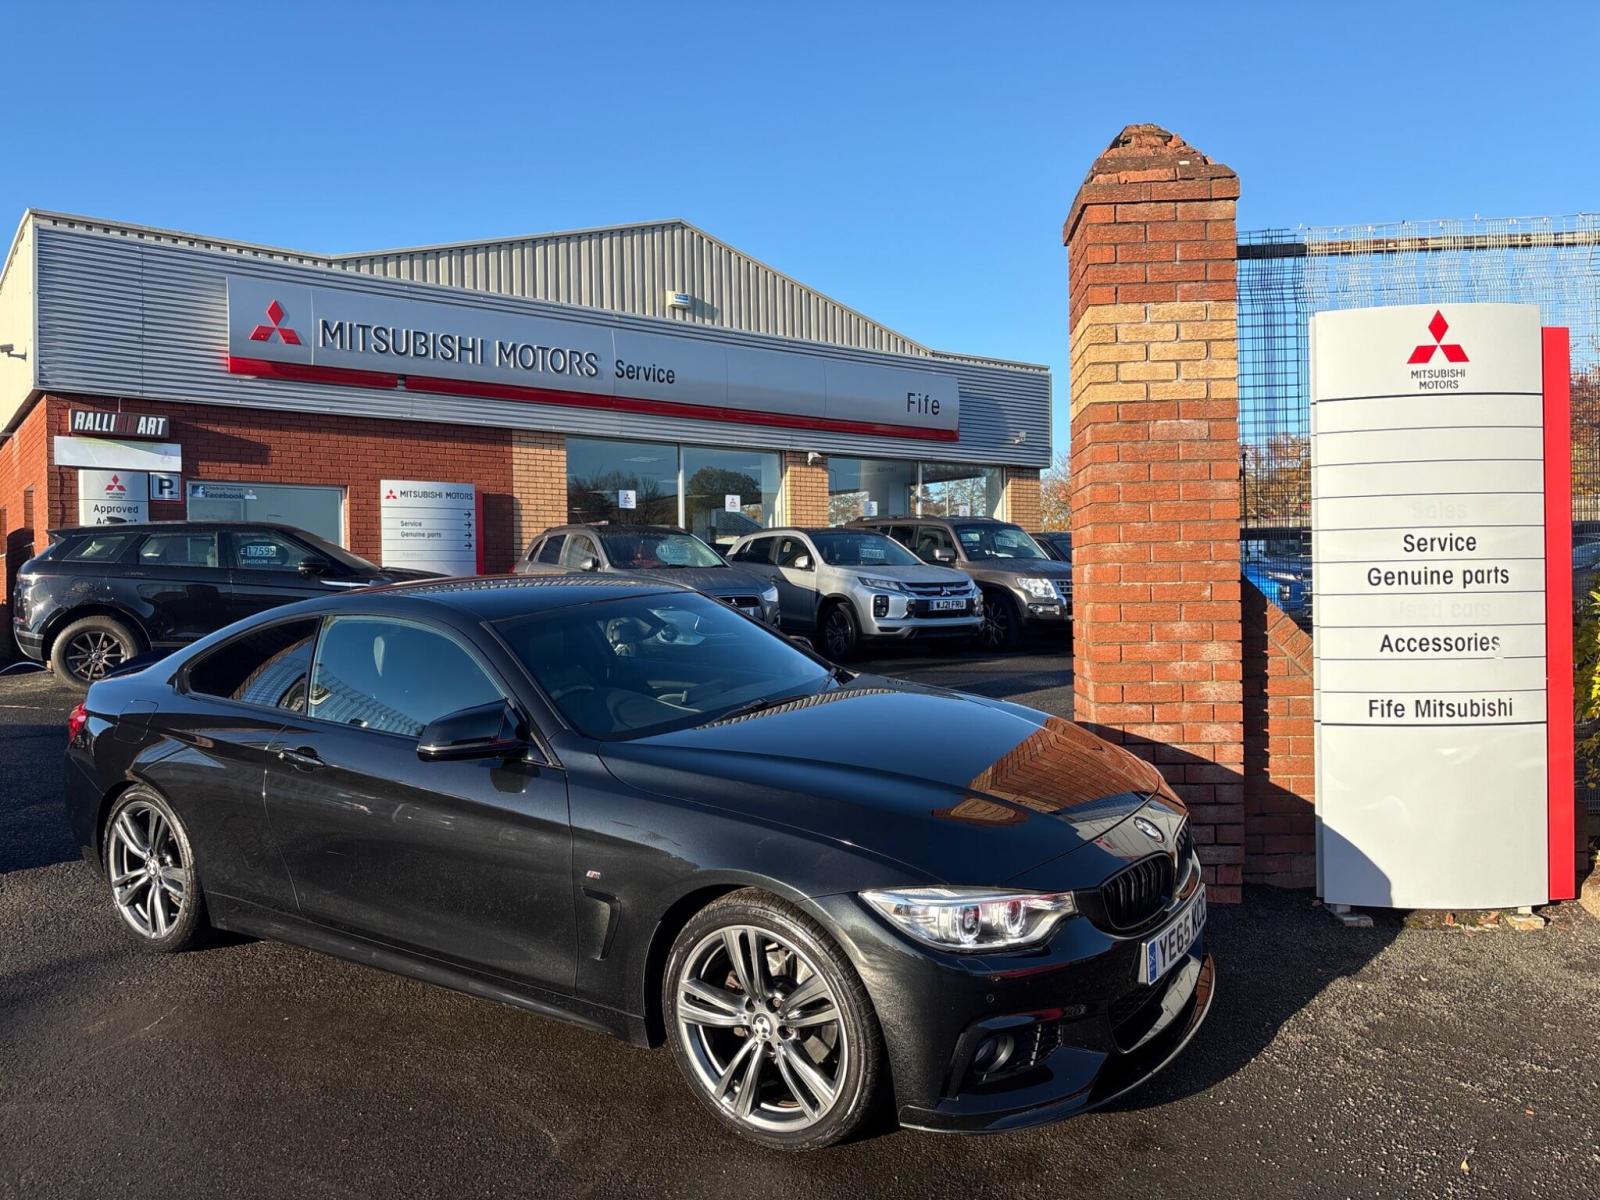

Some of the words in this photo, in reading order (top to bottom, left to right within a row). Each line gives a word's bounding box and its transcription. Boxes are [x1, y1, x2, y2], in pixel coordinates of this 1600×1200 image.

[319, 319, 484, 365] MITSUBISHI
[495, 340, 599, 377] MOTORS
[614, 359, 675, 384] Service
[1411, 369, 1466, 379] MITSUBISHI
[1419, 380, 1459, 390] MOTORS
[906, 392, 940, 415] Fife
[158, 478, 174, 495] P
[400, 490, 442, 499] MITSUBISHI
[446, 492, 473, 500] MOTORS
[93, 504, 139, 514] Approved
[1403, 533, 1477, 552] Service
[1367, 567, 1454, 586] Genuine
[1463, 566, 1510, 589] parts
[951, 600, 964, 608] FRU
[1379, 633, 1501, 653] Accessories
[1368, 699, 1405, 718] Fife
[1415, 698, 1513, 718] Mitsubishi
[1159, 914, 1191, 969] YE65
